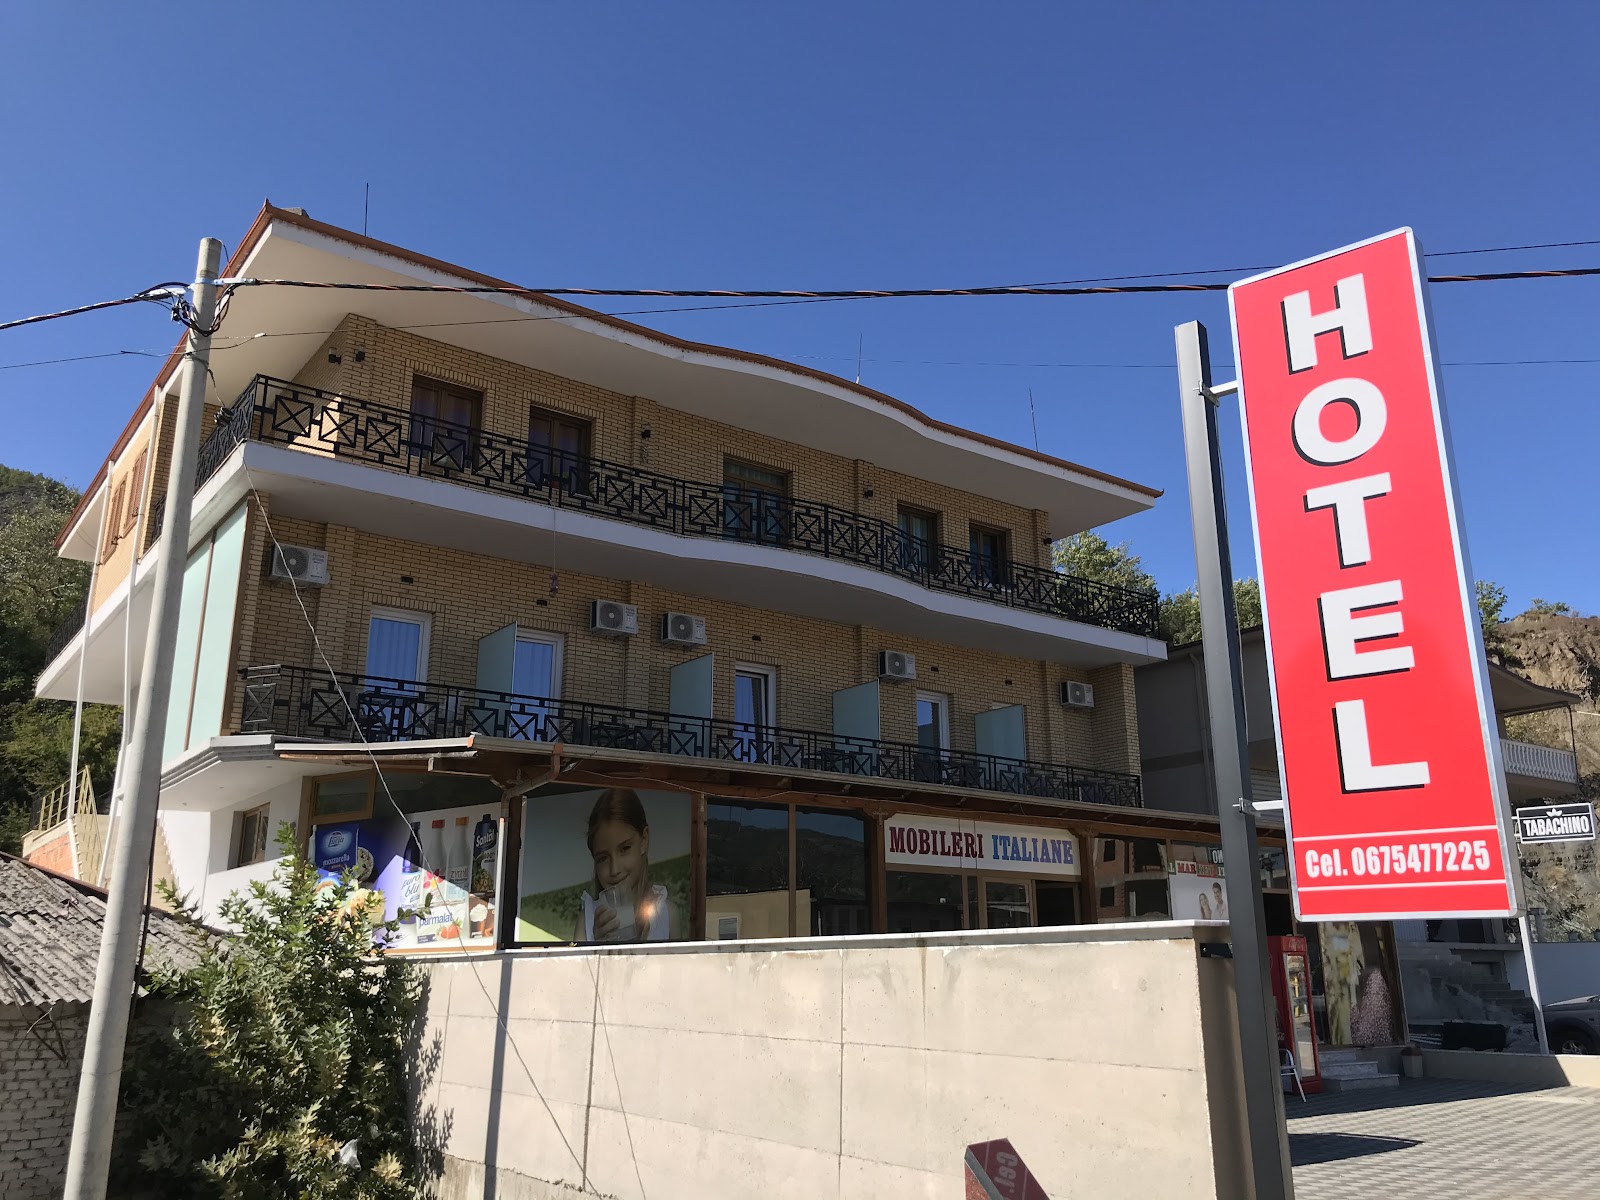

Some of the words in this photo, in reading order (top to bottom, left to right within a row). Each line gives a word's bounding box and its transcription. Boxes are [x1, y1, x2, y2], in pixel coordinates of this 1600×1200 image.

[1280, 272, 1430, 794] HOTEL
[1523, 815, 1590, 836] TABACHINO
[323, 853, 350, 866] mozzarella
[889, 826, 984, 859] MOBILERI
[992, 834, 1073, 865] ITALIANE
[1305, 848, 1348, 878] Cel.
[1351, 840, 1490, 876] 0675477225
